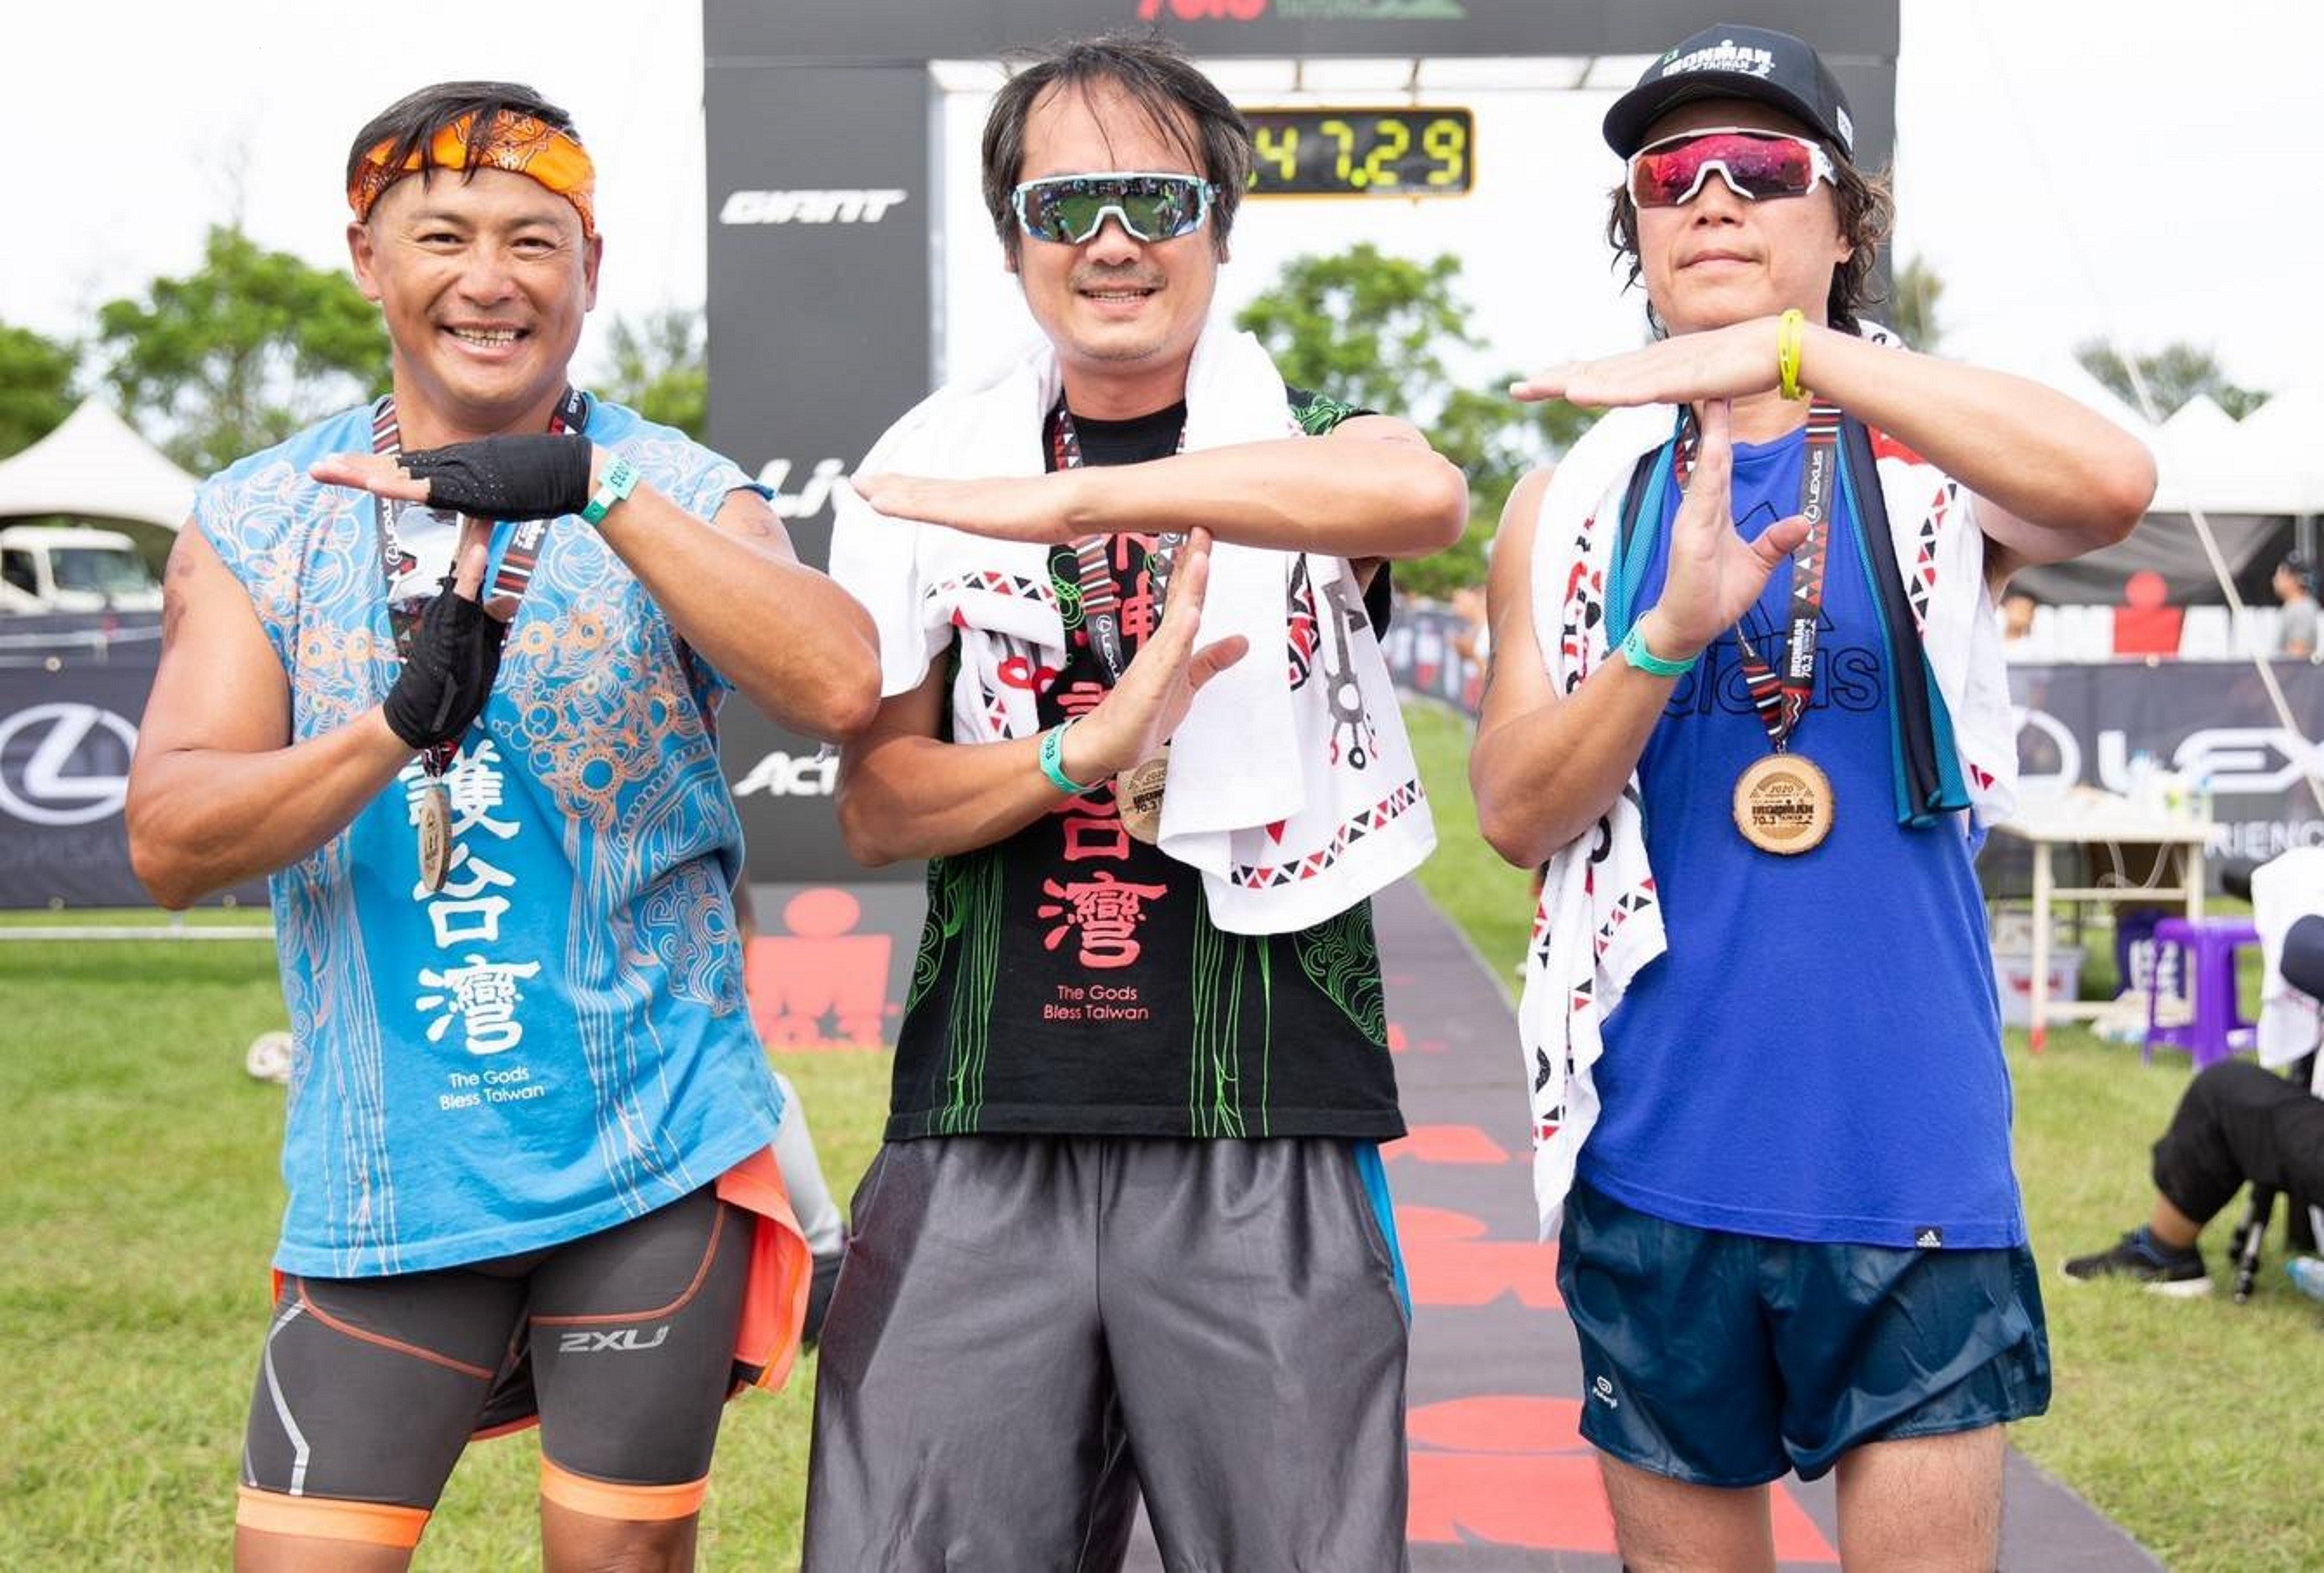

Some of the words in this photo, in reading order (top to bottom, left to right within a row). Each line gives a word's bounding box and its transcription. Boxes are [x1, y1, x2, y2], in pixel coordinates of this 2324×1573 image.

[1662, 43, 1771, 77] IRONMAN
[719, 189, 907, 224] GIANT
[1057, 986, 1085, 1000] The
[1089, 986, 1138, 1000] Gods
[1043, 1004, 1082, 1020] Bless
[1086, 1004, 1149, 1020] Taiwan
[450, 1072, 479, 1088] The
[484, 1067, 530, 1085] Gods
[440, 1093, 481, 1110] Bless
[484, 1085, 545, 1103] Taiwan
[559, 1325, 670, 1352] 2XU
